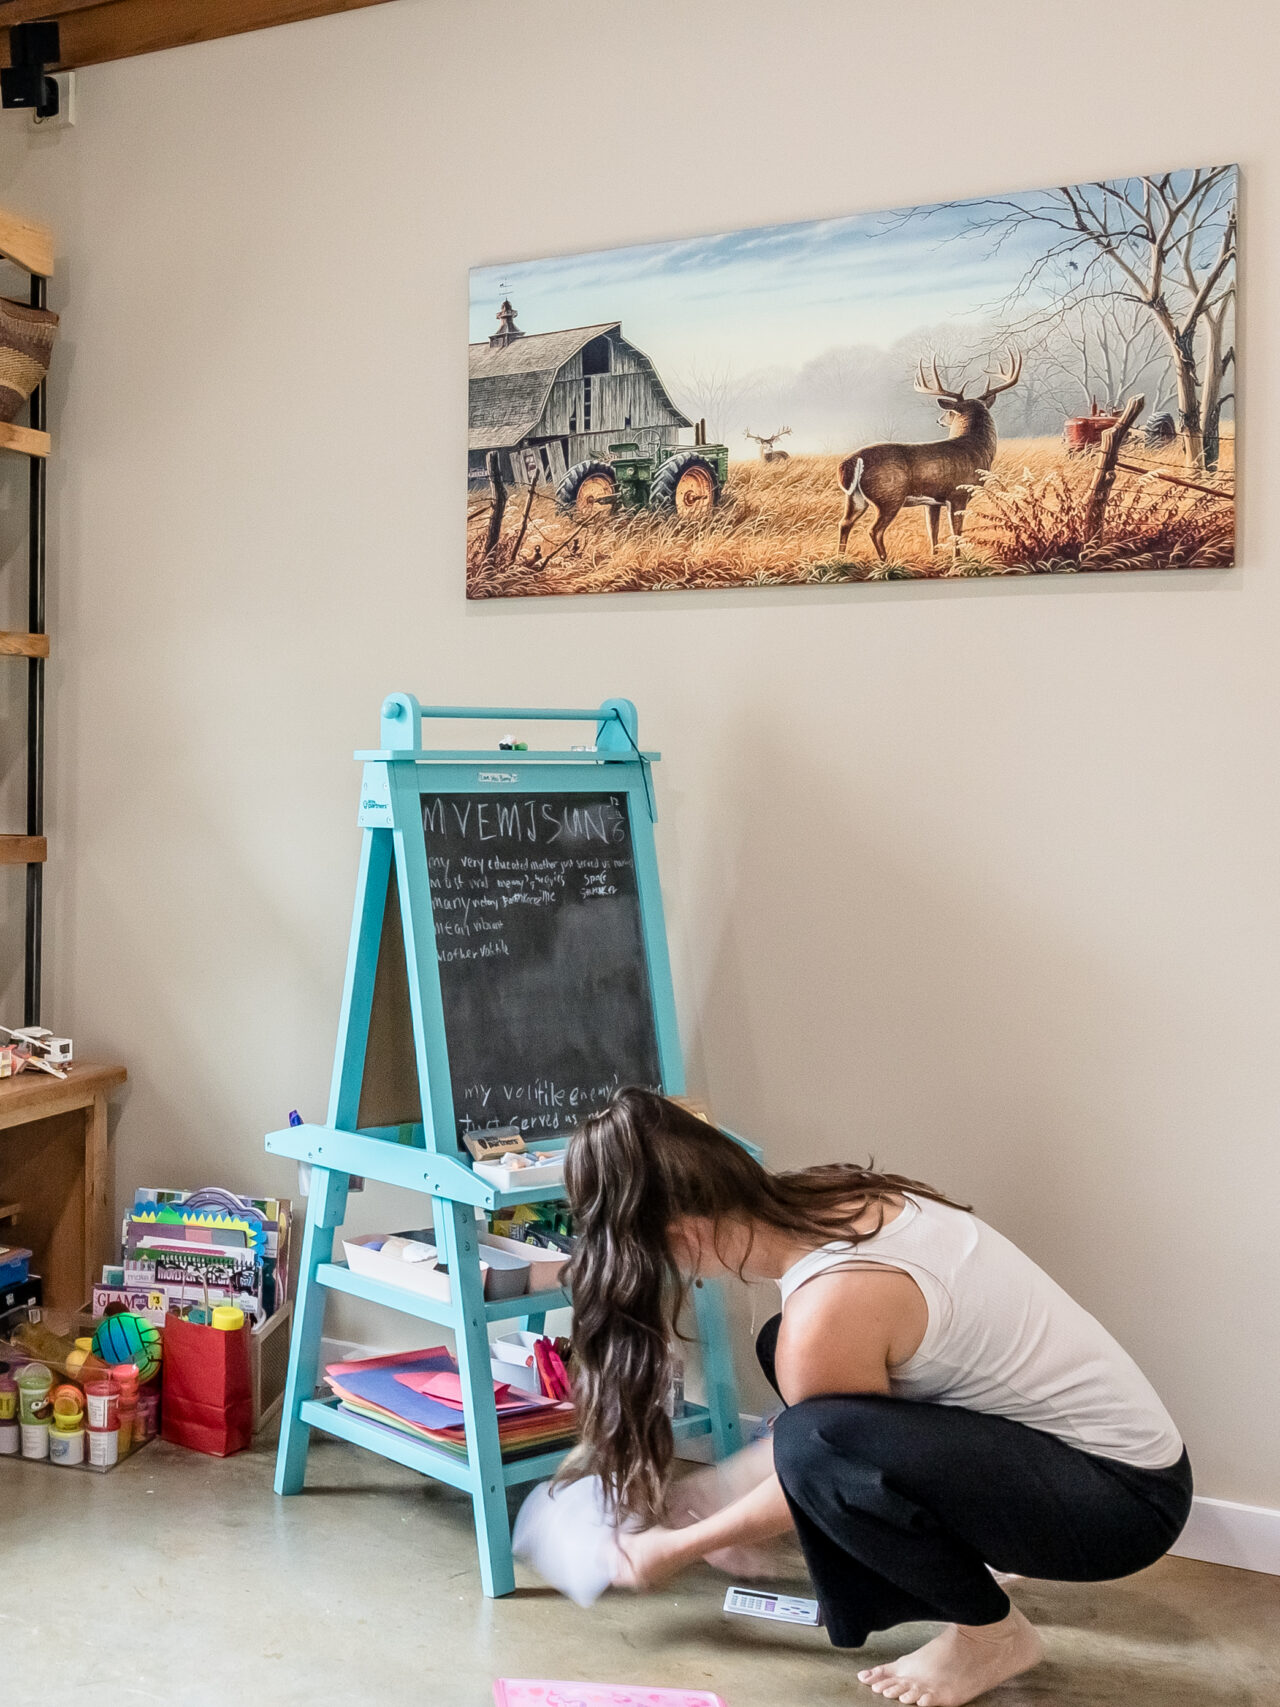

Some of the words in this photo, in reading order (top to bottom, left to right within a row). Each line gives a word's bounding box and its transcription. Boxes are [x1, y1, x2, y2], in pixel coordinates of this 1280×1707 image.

[428, 857, 450, 879] my
[461, 856, 484, 874] very
[488, 855, 528, 870] educated
[465, 1084, 491, 1107] my
